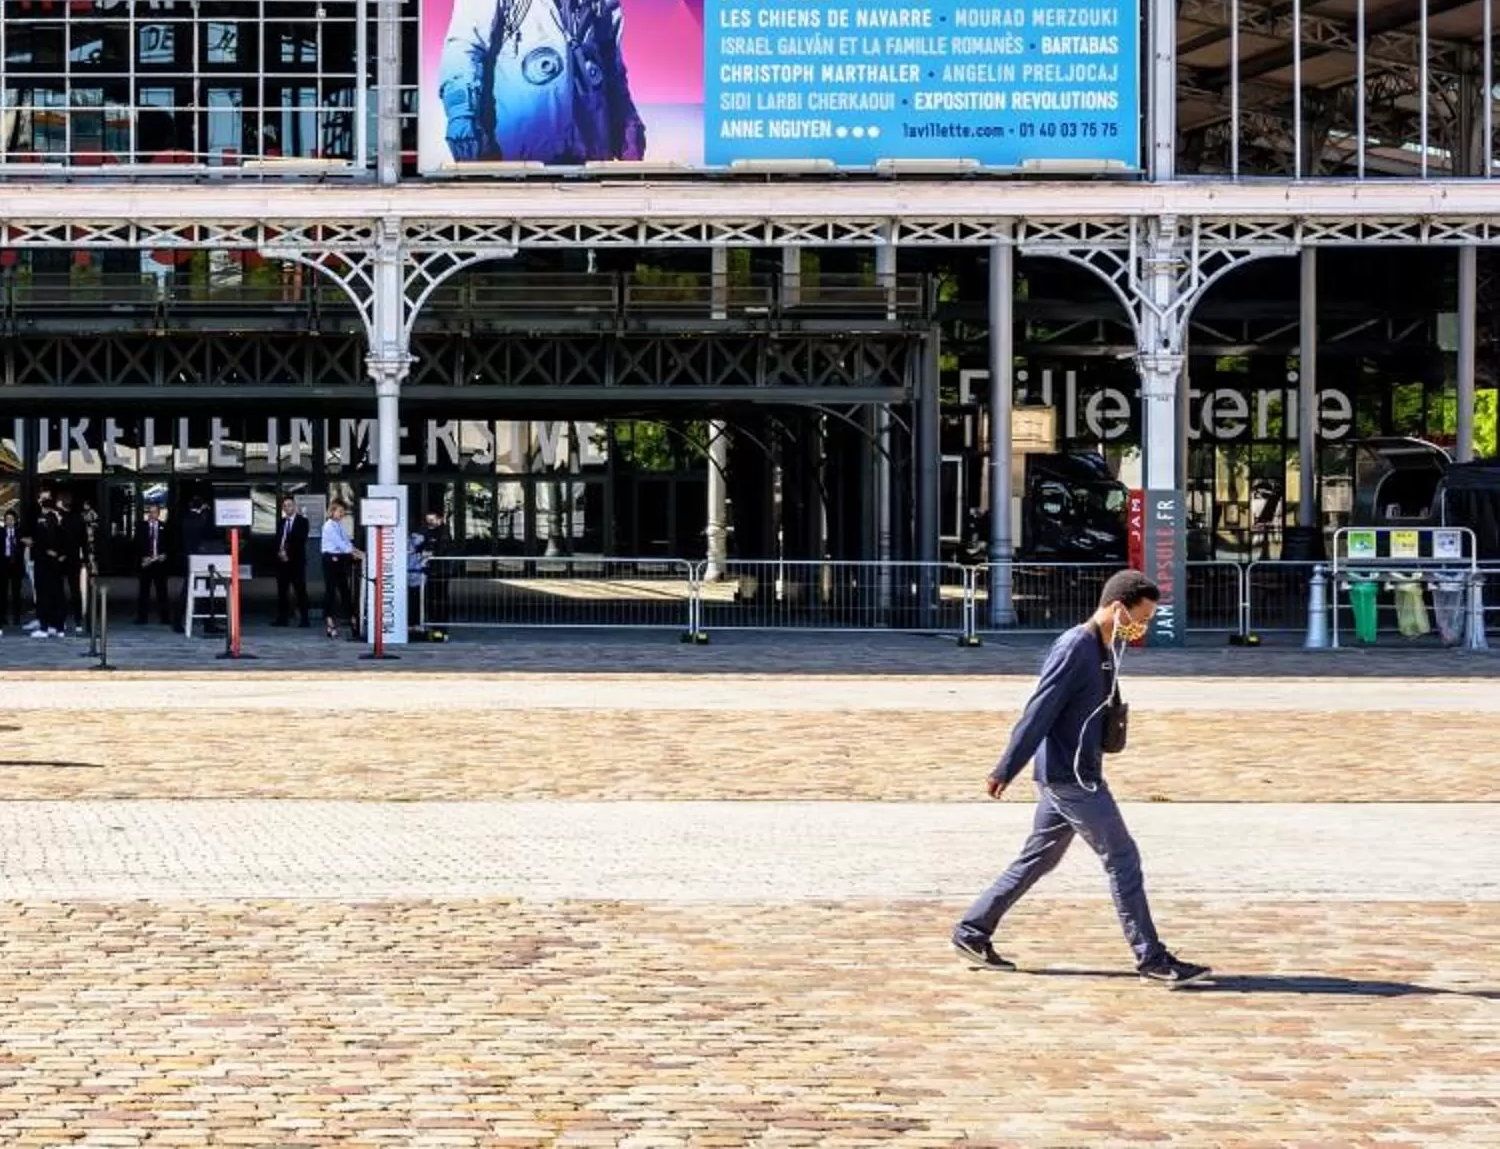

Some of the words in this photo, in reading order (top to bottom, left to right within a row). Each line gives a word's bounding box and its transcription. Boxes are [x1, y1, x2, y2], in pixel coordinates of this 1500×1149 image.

[720, 8, 751, 28] LES
[758, 8, 821, 28] CHIENS
[827, 8, 849, 28] DE
[856, 8, 933, 28] NAVARRE
[955, 8, 1025, 28] MOURAD
[1032, 8, 1118, 28] MERZOUKI
[720, 36, 773, 55] ISRAEL
[838, 36, 858, 55] ET
[862, 36, 881, 55] LA
[885, 36, 948, 55] FAMILLE
[951, 31, 1025, 55] ROMANÈS
[1041, 36, 1119, 55] BARTABAS
[720, 64, 814, 84] CHRISTOPH
[821, 64, 921, 84] MARTHALER
[942, 64, 1016, 84] ANGELIN
[1022, 64, 1119, 84] PRELJOCAJ
[720, 91, 751, 111] SIDI
[757, 91, 803, 111] LARBI
[808, 91, 896, 111] CHERKAOUI
[915, 91, 1006, 111] EXPOSITION
[1011, 91, 1119, 111] REVOLUTIONS
[720, 119, 764, 139] ANNE
[769, 119, 832, 139] NGUYEN
[902, 122, 1005, 139] lavillette.com
[1019, 122, 1036, 139] 01
[1039, 122, 1057, 139] 40
[1060, 122, 1078, 139] 03
[1155, 499, 1176, 639] JAMCAPSULE.FR
